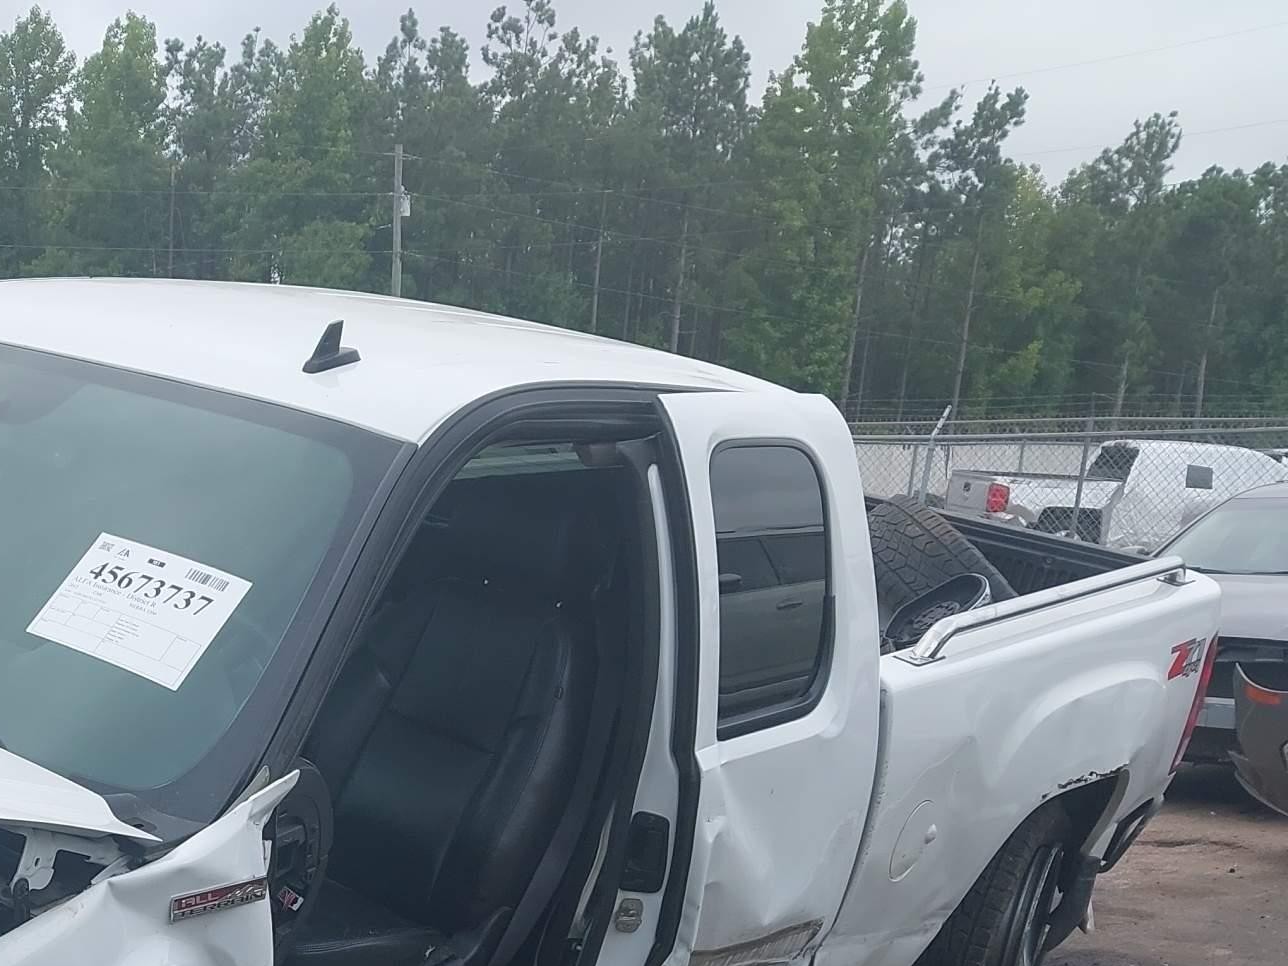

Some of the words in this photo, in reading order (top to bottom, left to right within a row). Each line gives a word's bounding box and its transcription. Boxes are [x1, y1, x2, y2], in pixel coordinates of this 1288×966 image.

[89, 561, 215, 616] 45673737
[177, 888, 266, 918] TERRAIN
[181, 892, 220, 909] ALL
